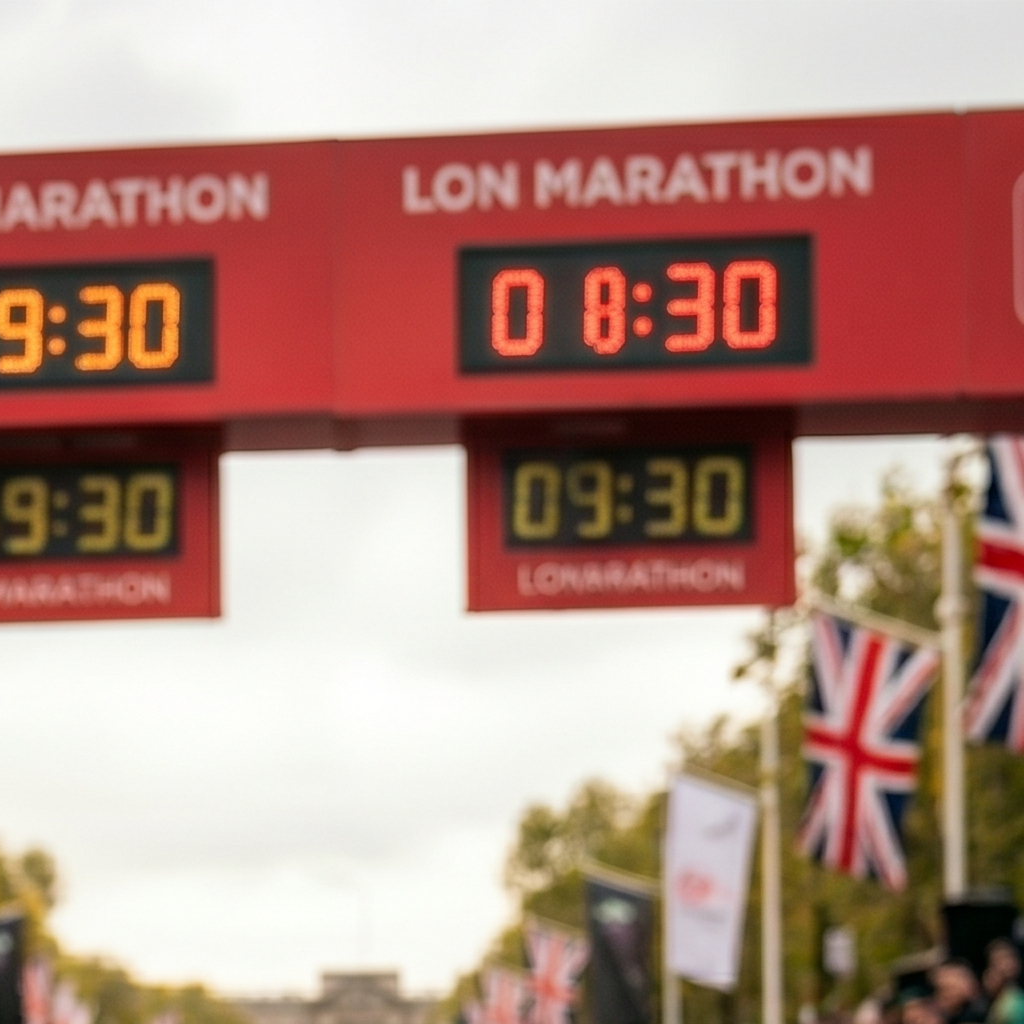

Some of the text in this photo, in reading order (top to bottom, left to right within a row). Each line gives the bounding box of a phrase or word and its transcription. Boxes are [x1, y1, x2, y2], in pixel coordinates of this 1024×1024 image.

[402, 146, 873, 215] LON MARATHON
[511, 456, 744, 540] 09:30
